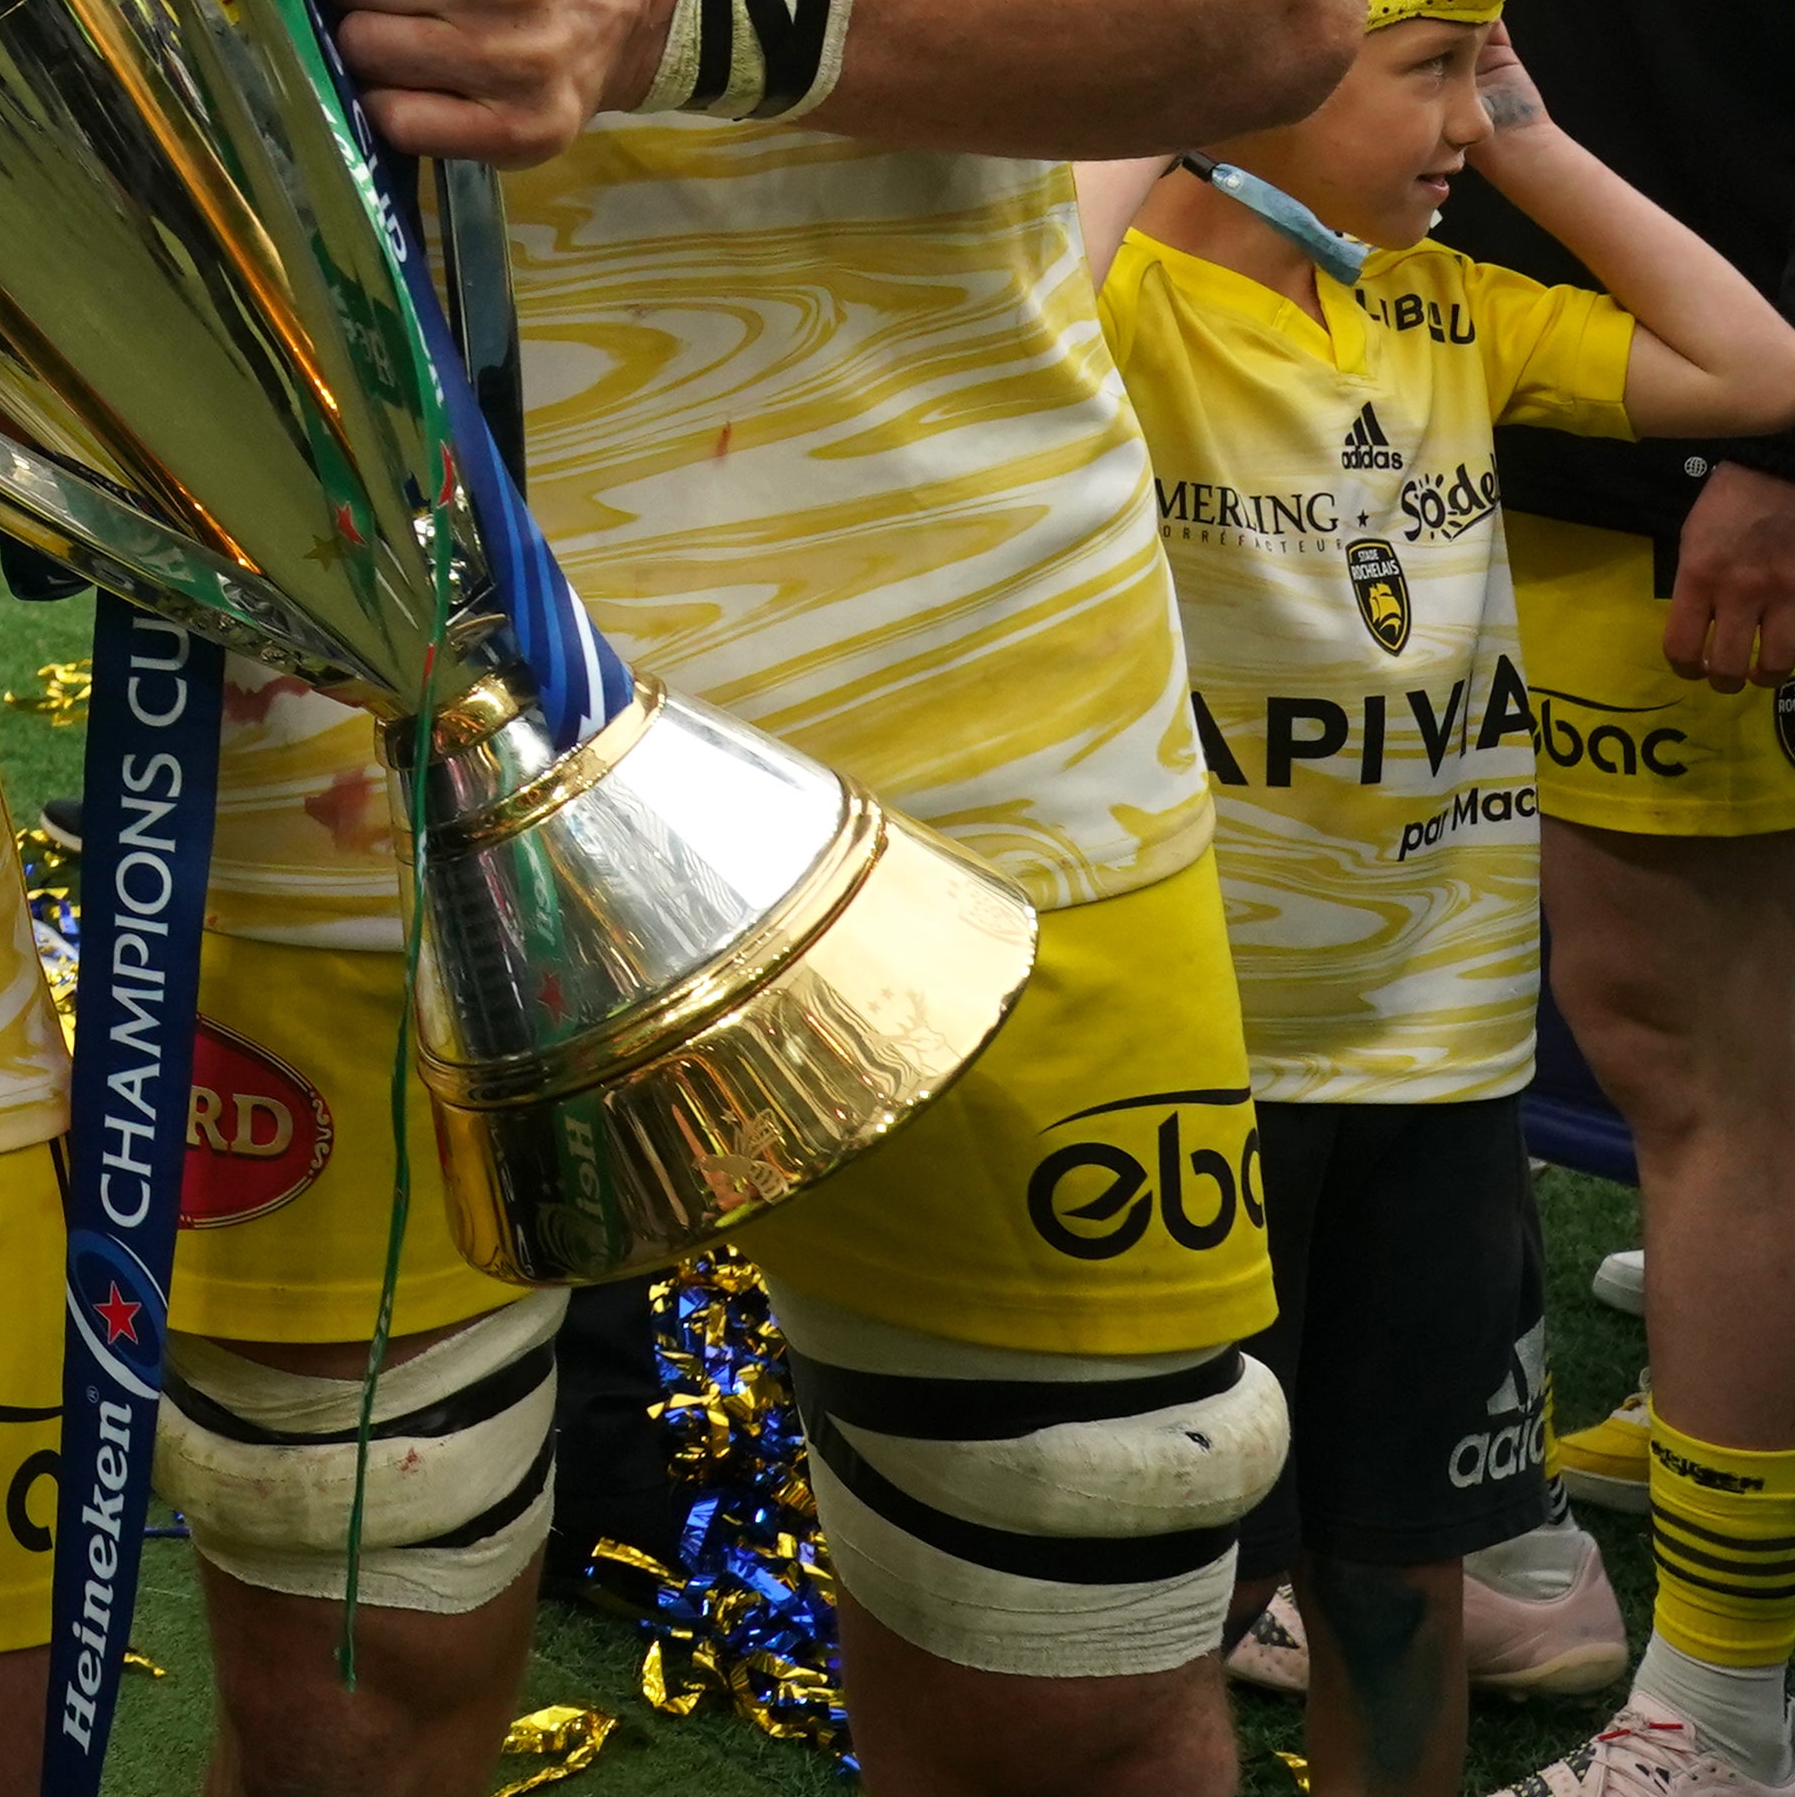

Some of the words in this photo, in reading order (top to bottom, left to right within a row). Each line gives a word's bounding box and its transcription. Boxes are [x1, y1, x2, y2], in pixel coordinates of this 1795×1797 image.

[1341, 443, 1404, 471] adidas
[1351, 561, 1401, 581] ROCHELAIS
[1531, 699, 1690, 777] bac
[1451, 786, 1541, 828] Mac
[100, 751, 184, 1229] CHAMPIONS
[62, 1398, 133, 1757] Heineken
